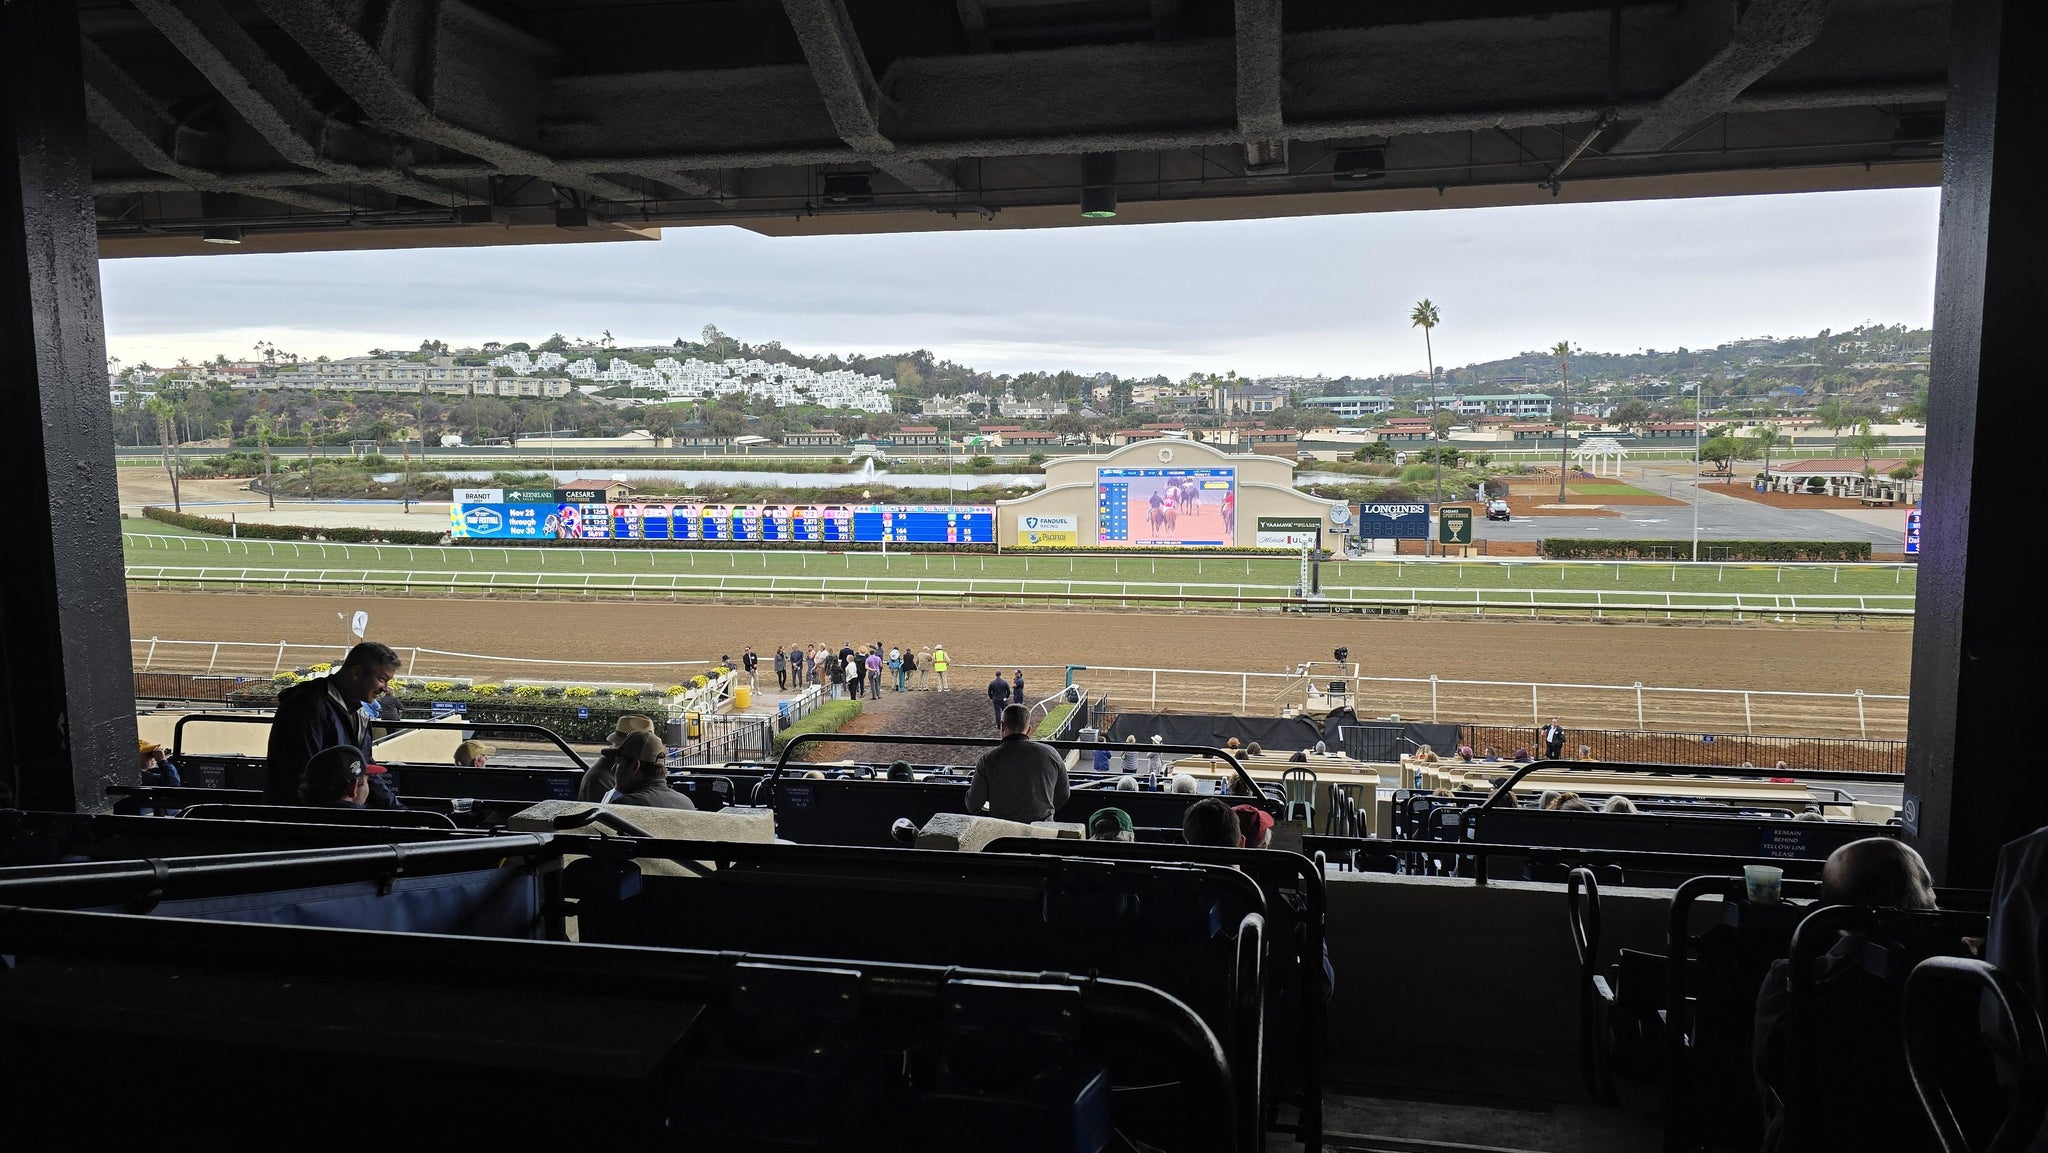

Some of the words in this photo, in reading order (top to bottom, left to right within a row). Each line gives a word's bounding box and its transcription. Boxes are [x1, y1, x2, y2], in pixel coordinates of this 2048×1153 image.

[1364, 504, 1424, 514] LONGINES
[479, 516, 498, 524] FESTIVAL
[509, 518, 536, 528] through
